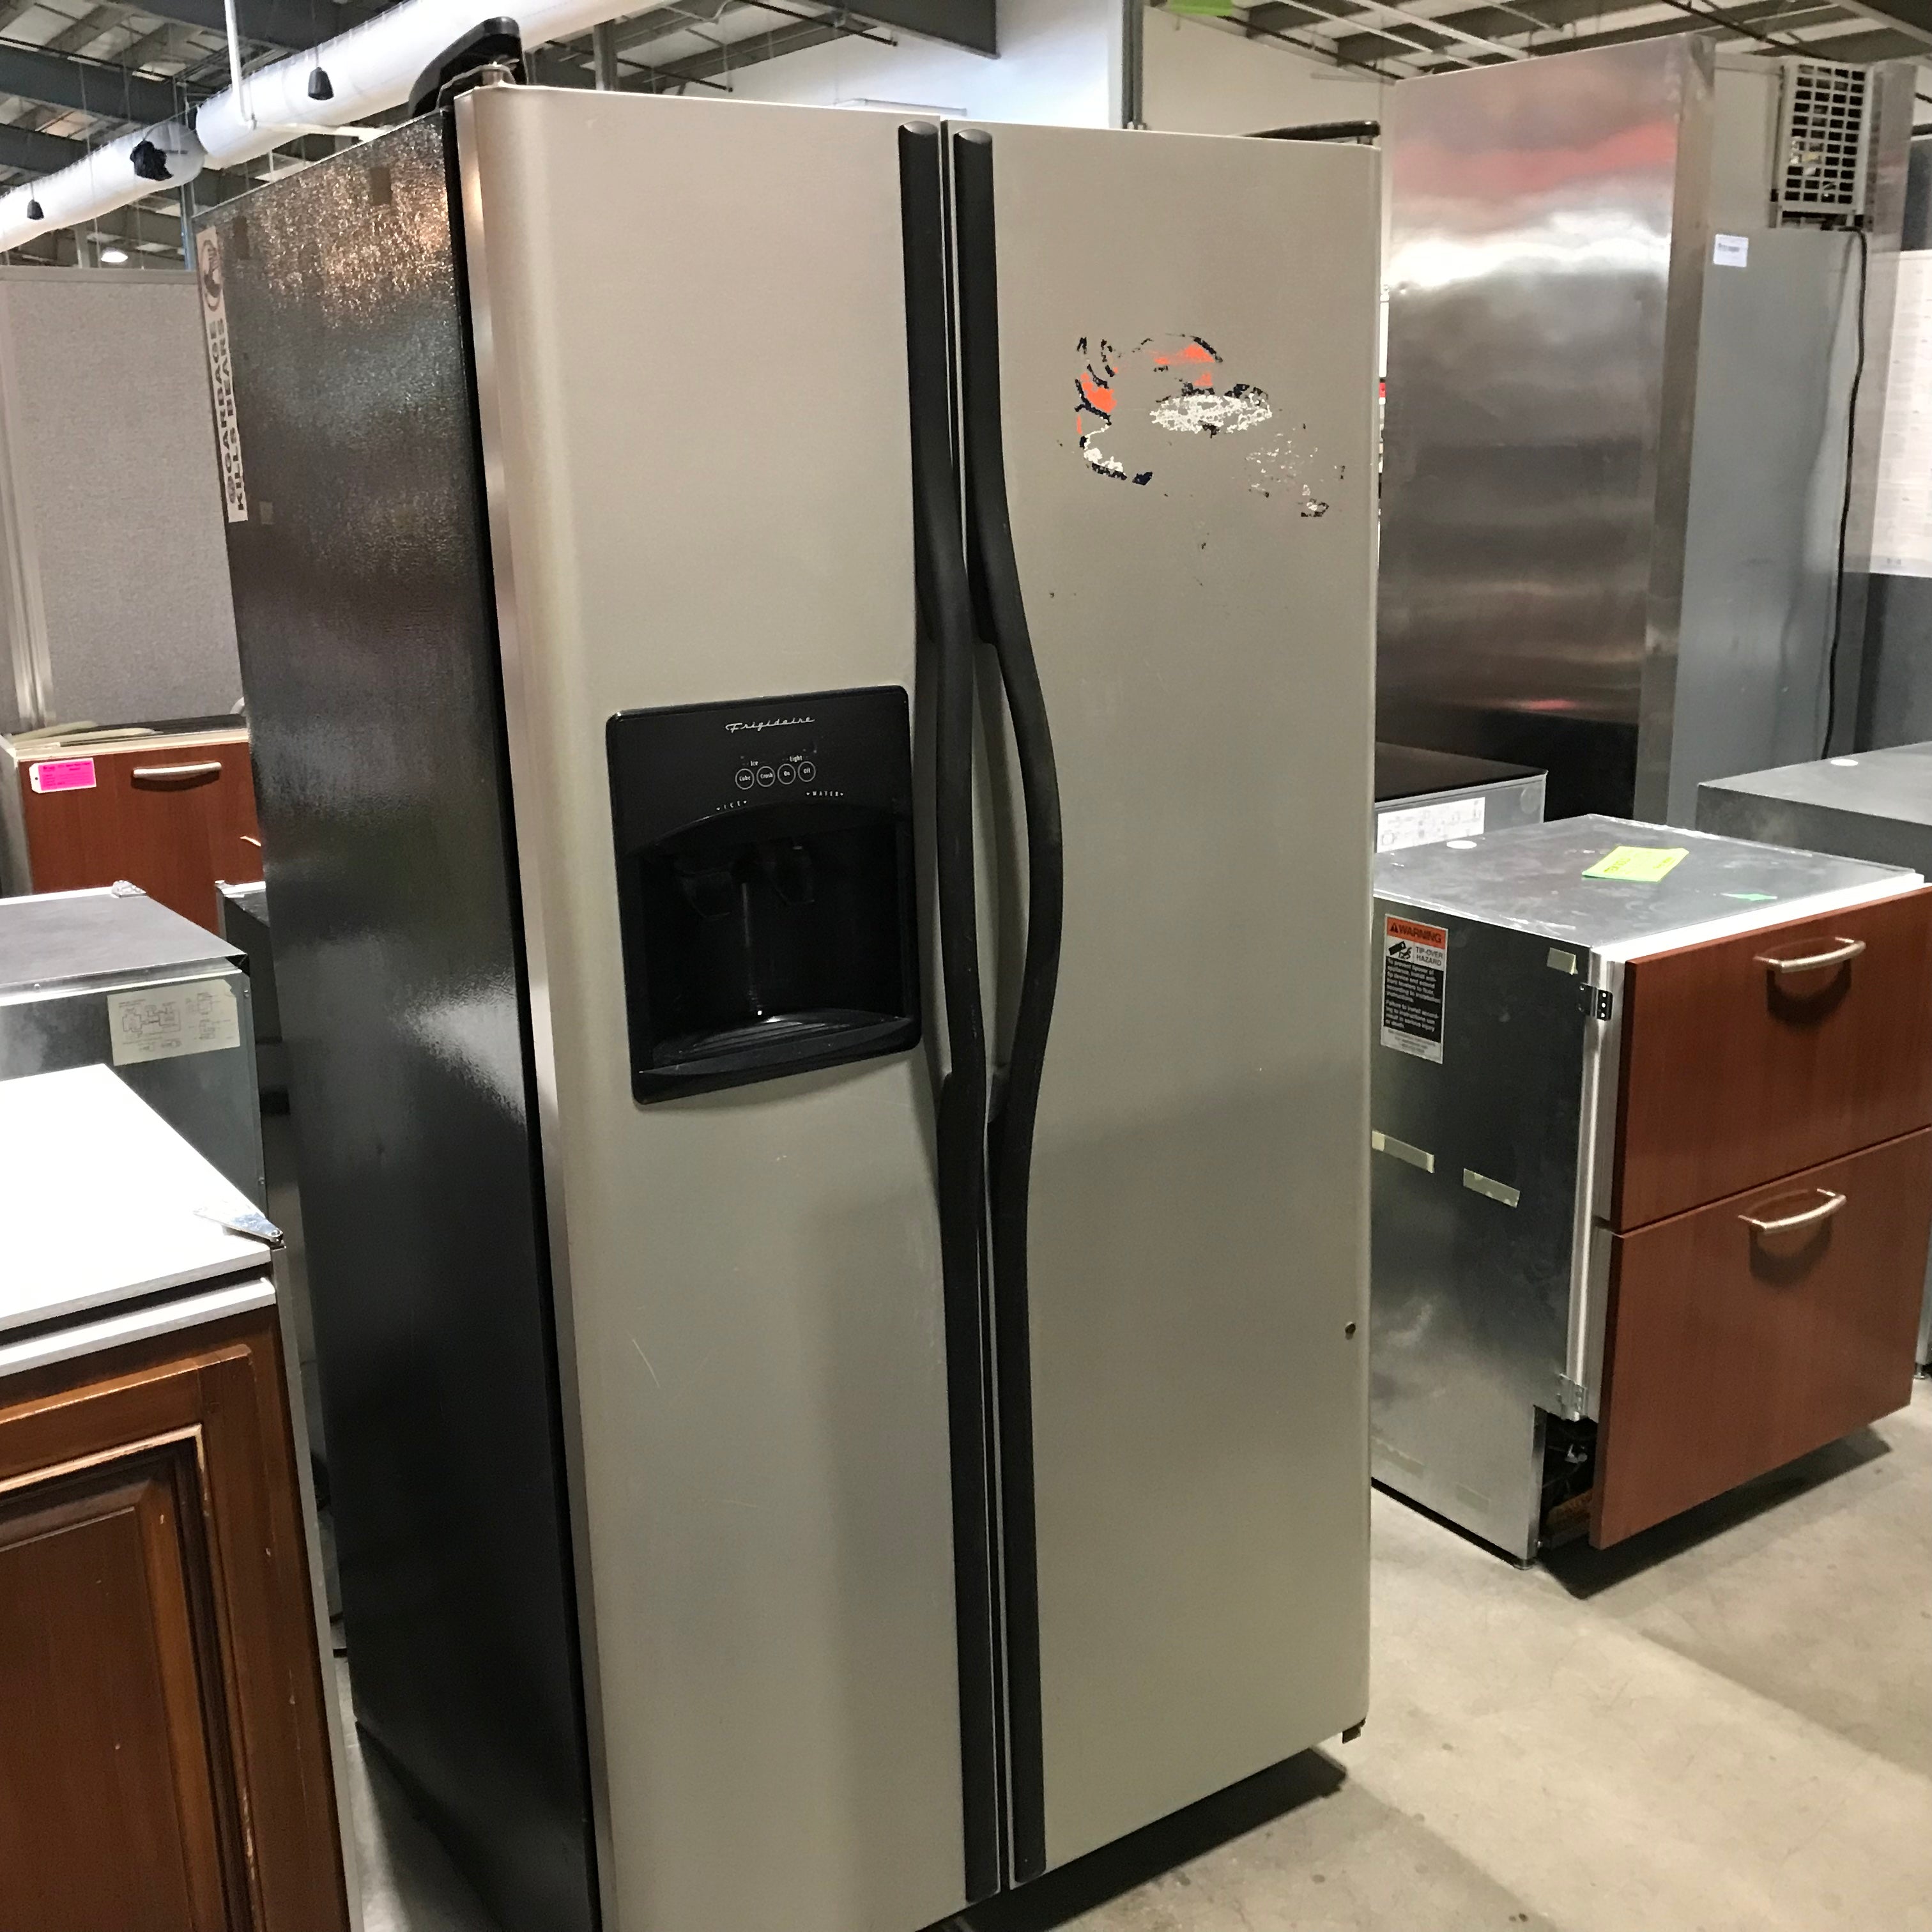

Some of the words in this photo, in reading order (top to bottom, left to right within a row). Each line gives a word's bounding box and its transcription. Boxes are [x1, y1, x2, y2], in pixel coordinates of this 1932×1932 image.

[229, 425, 244, 511] KILLS
[725, 717, 815, 733] Frigidaire
[723, 800, 741, 809] ICE
[1399, 924, 1442, 944] WARNING
[1416, 946, 1443, 959] TIP-OVER
[1416, 954, 1442, 967] HAZARD
